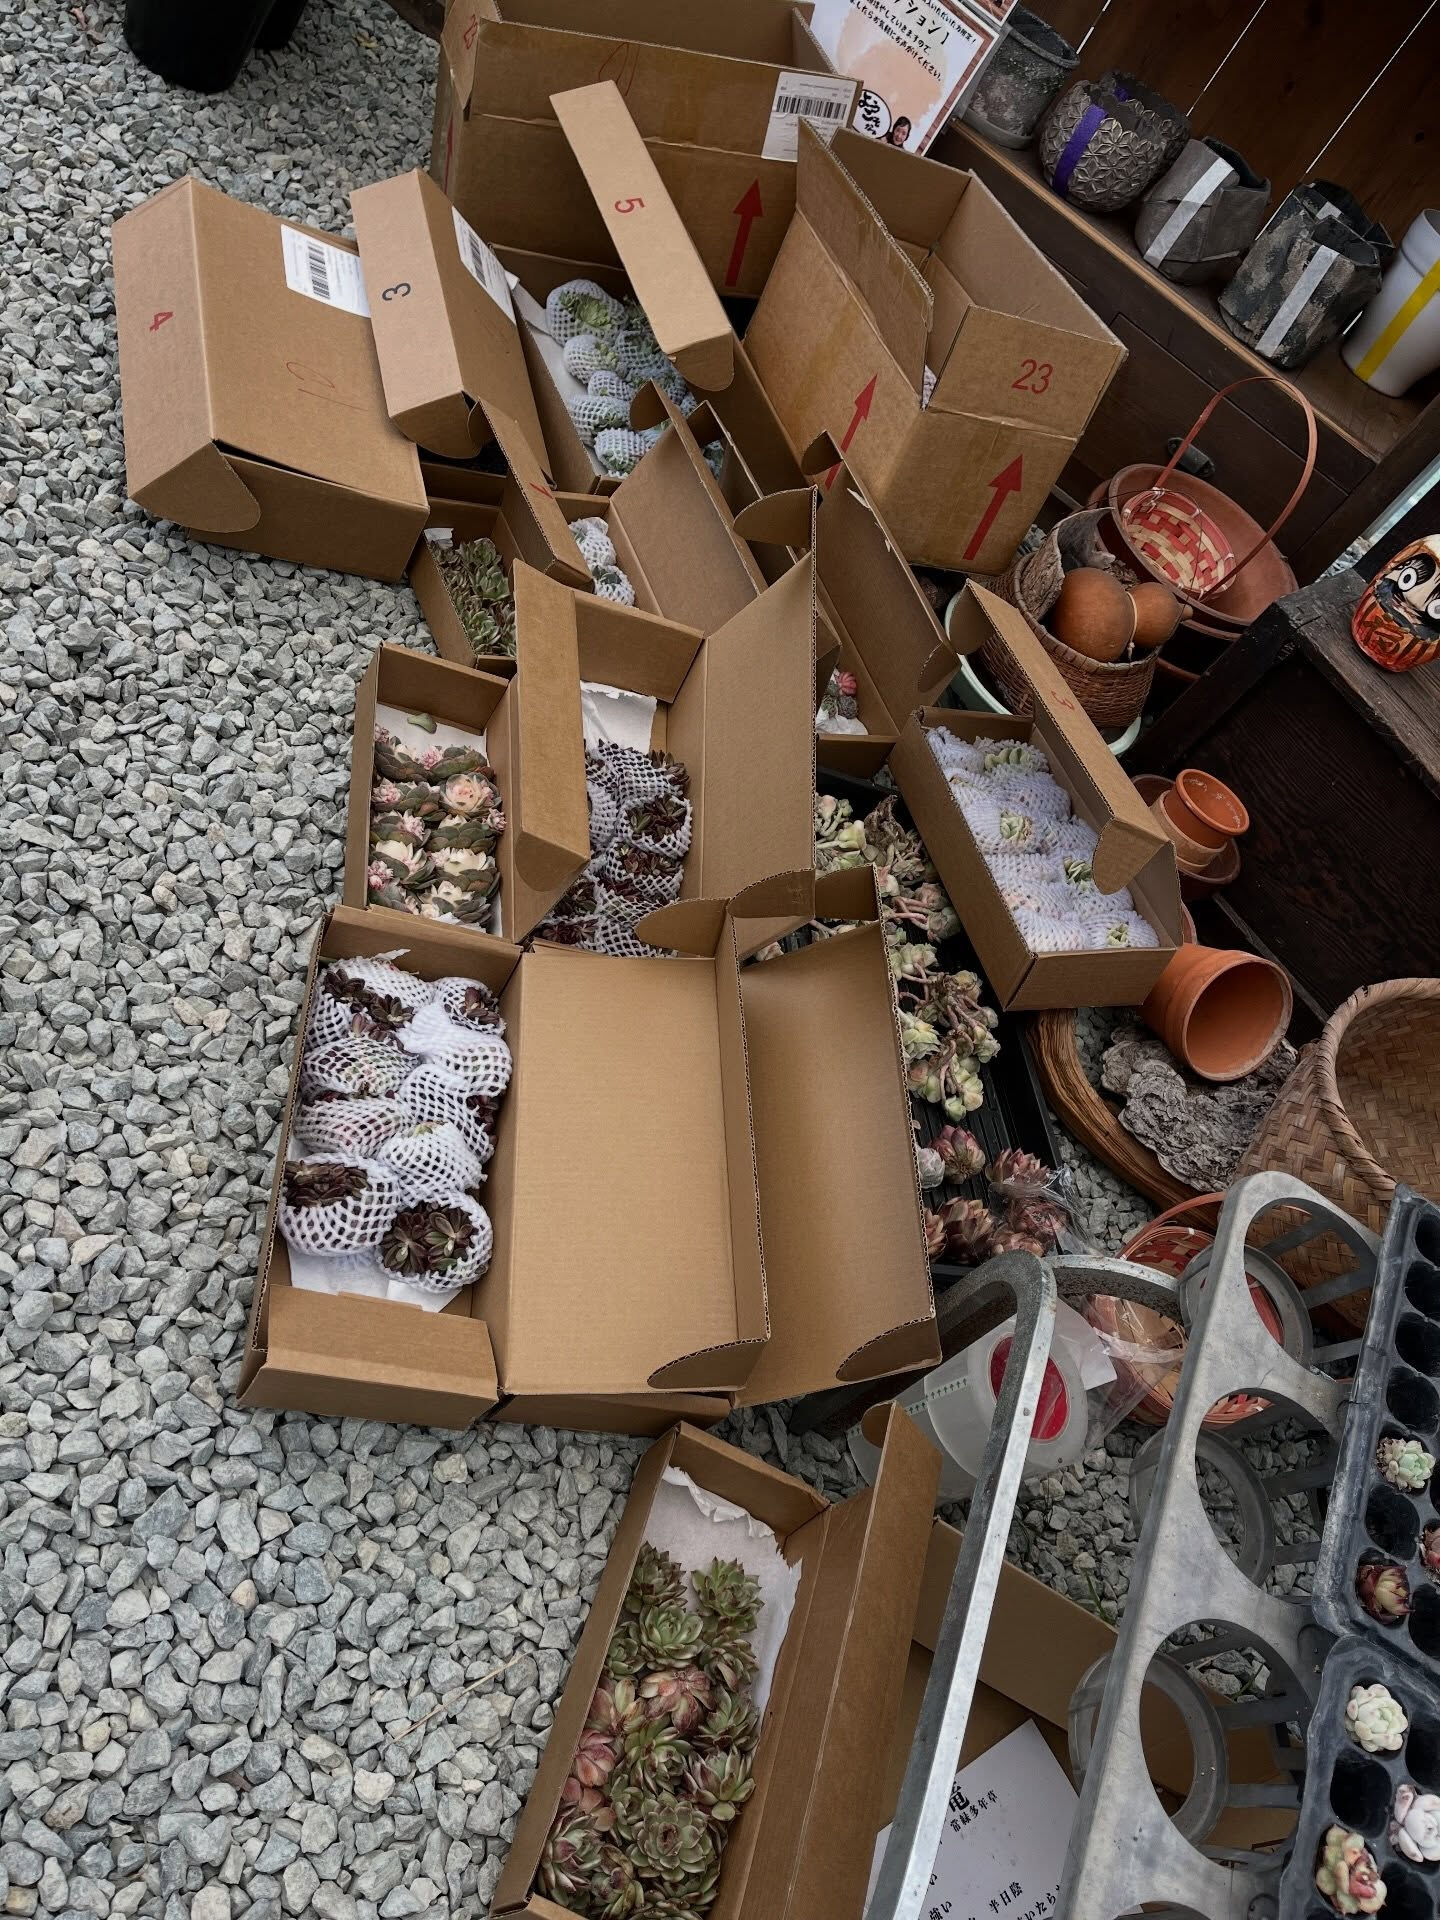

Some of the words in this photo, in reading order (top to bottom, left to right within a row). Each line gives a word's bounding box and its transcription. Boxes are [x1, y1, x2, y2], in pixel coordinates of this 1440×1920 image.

[614, 196, 646, 214] 5
[381, 281, 412, 302] 3
[149, 310, 174, 332] 4
[1011, 358, 1055, 395] 23
[988, 1881, 1024, 1914] 半日陰
